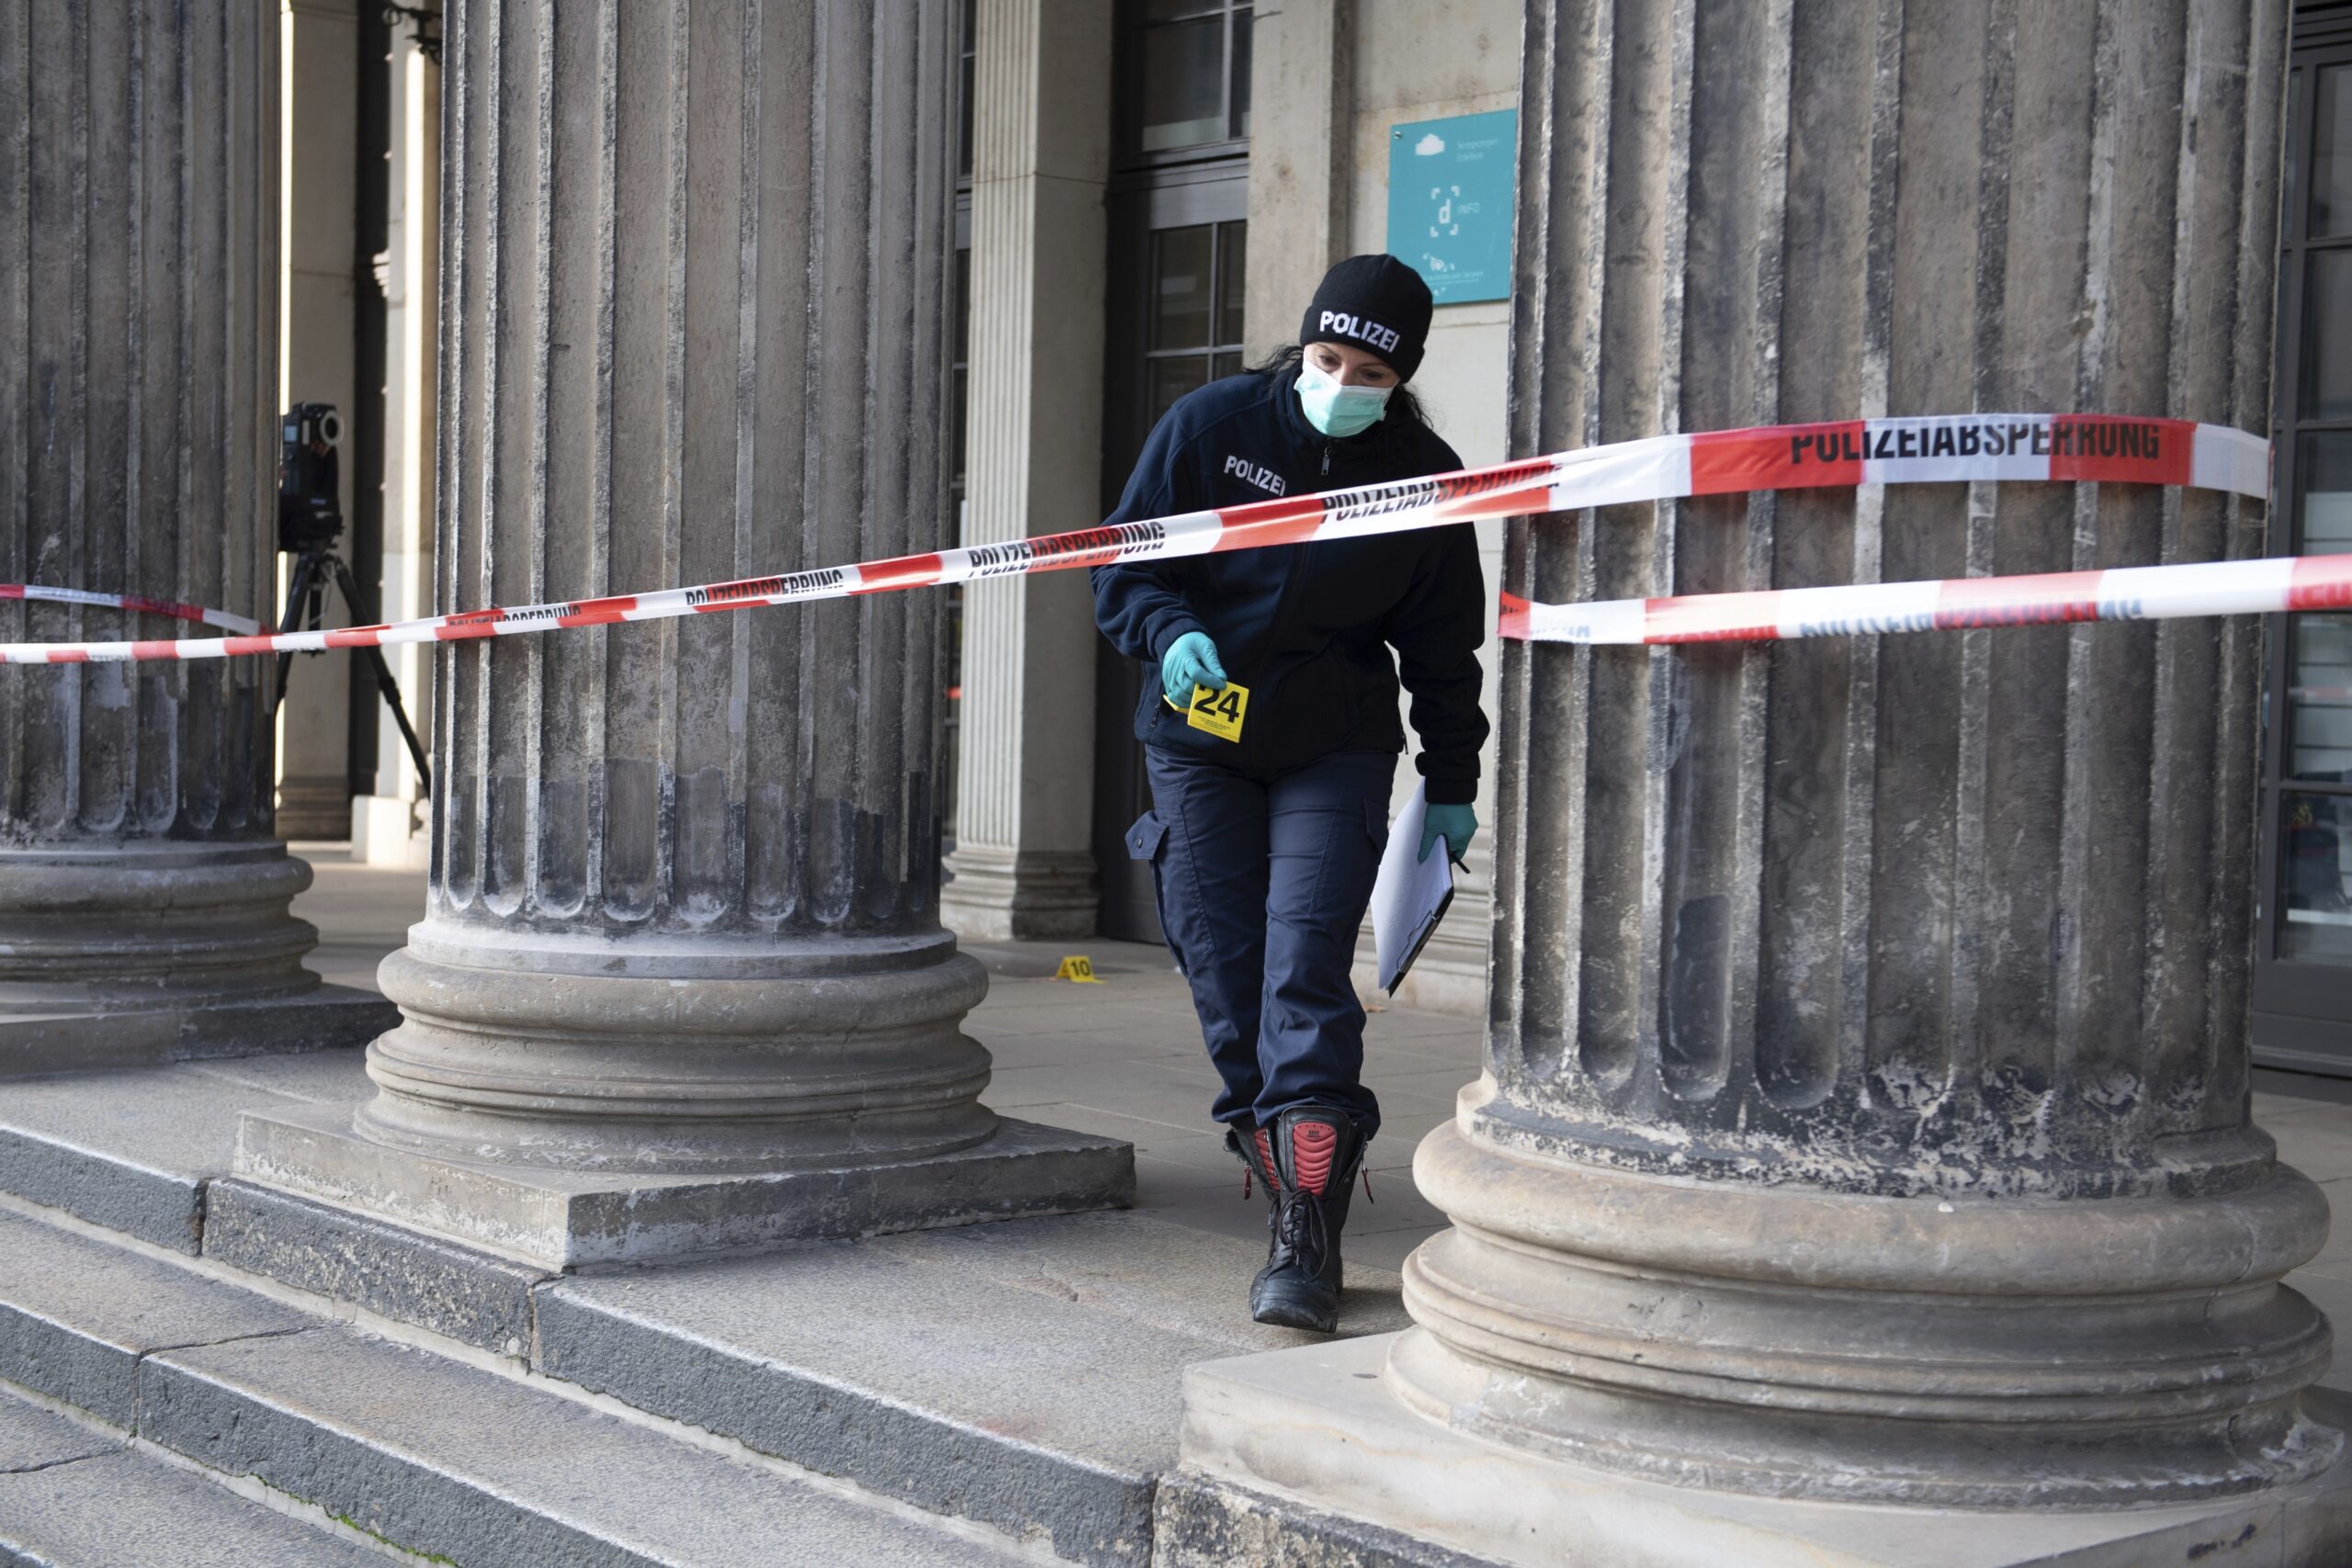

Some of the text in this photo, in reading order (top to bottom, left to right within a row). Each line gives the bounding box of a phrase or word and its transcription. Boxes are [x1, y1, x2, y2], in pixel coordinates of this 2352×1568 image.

[1319, 310, 1401, 354] POLIZEI
[1792, 423, 2160, 465] POLIZEIABSPERRUNG
[1223, 455, 1286, 497] POLIZEI
[1320, 463, 1562, 524] POLIZEIABSPERRU
[968, 521, 1165, 579] POLIZEIABSPERRUNG
[1193, 683, 1240, 724] 24
[1070, 960, 1091, 976] 10
